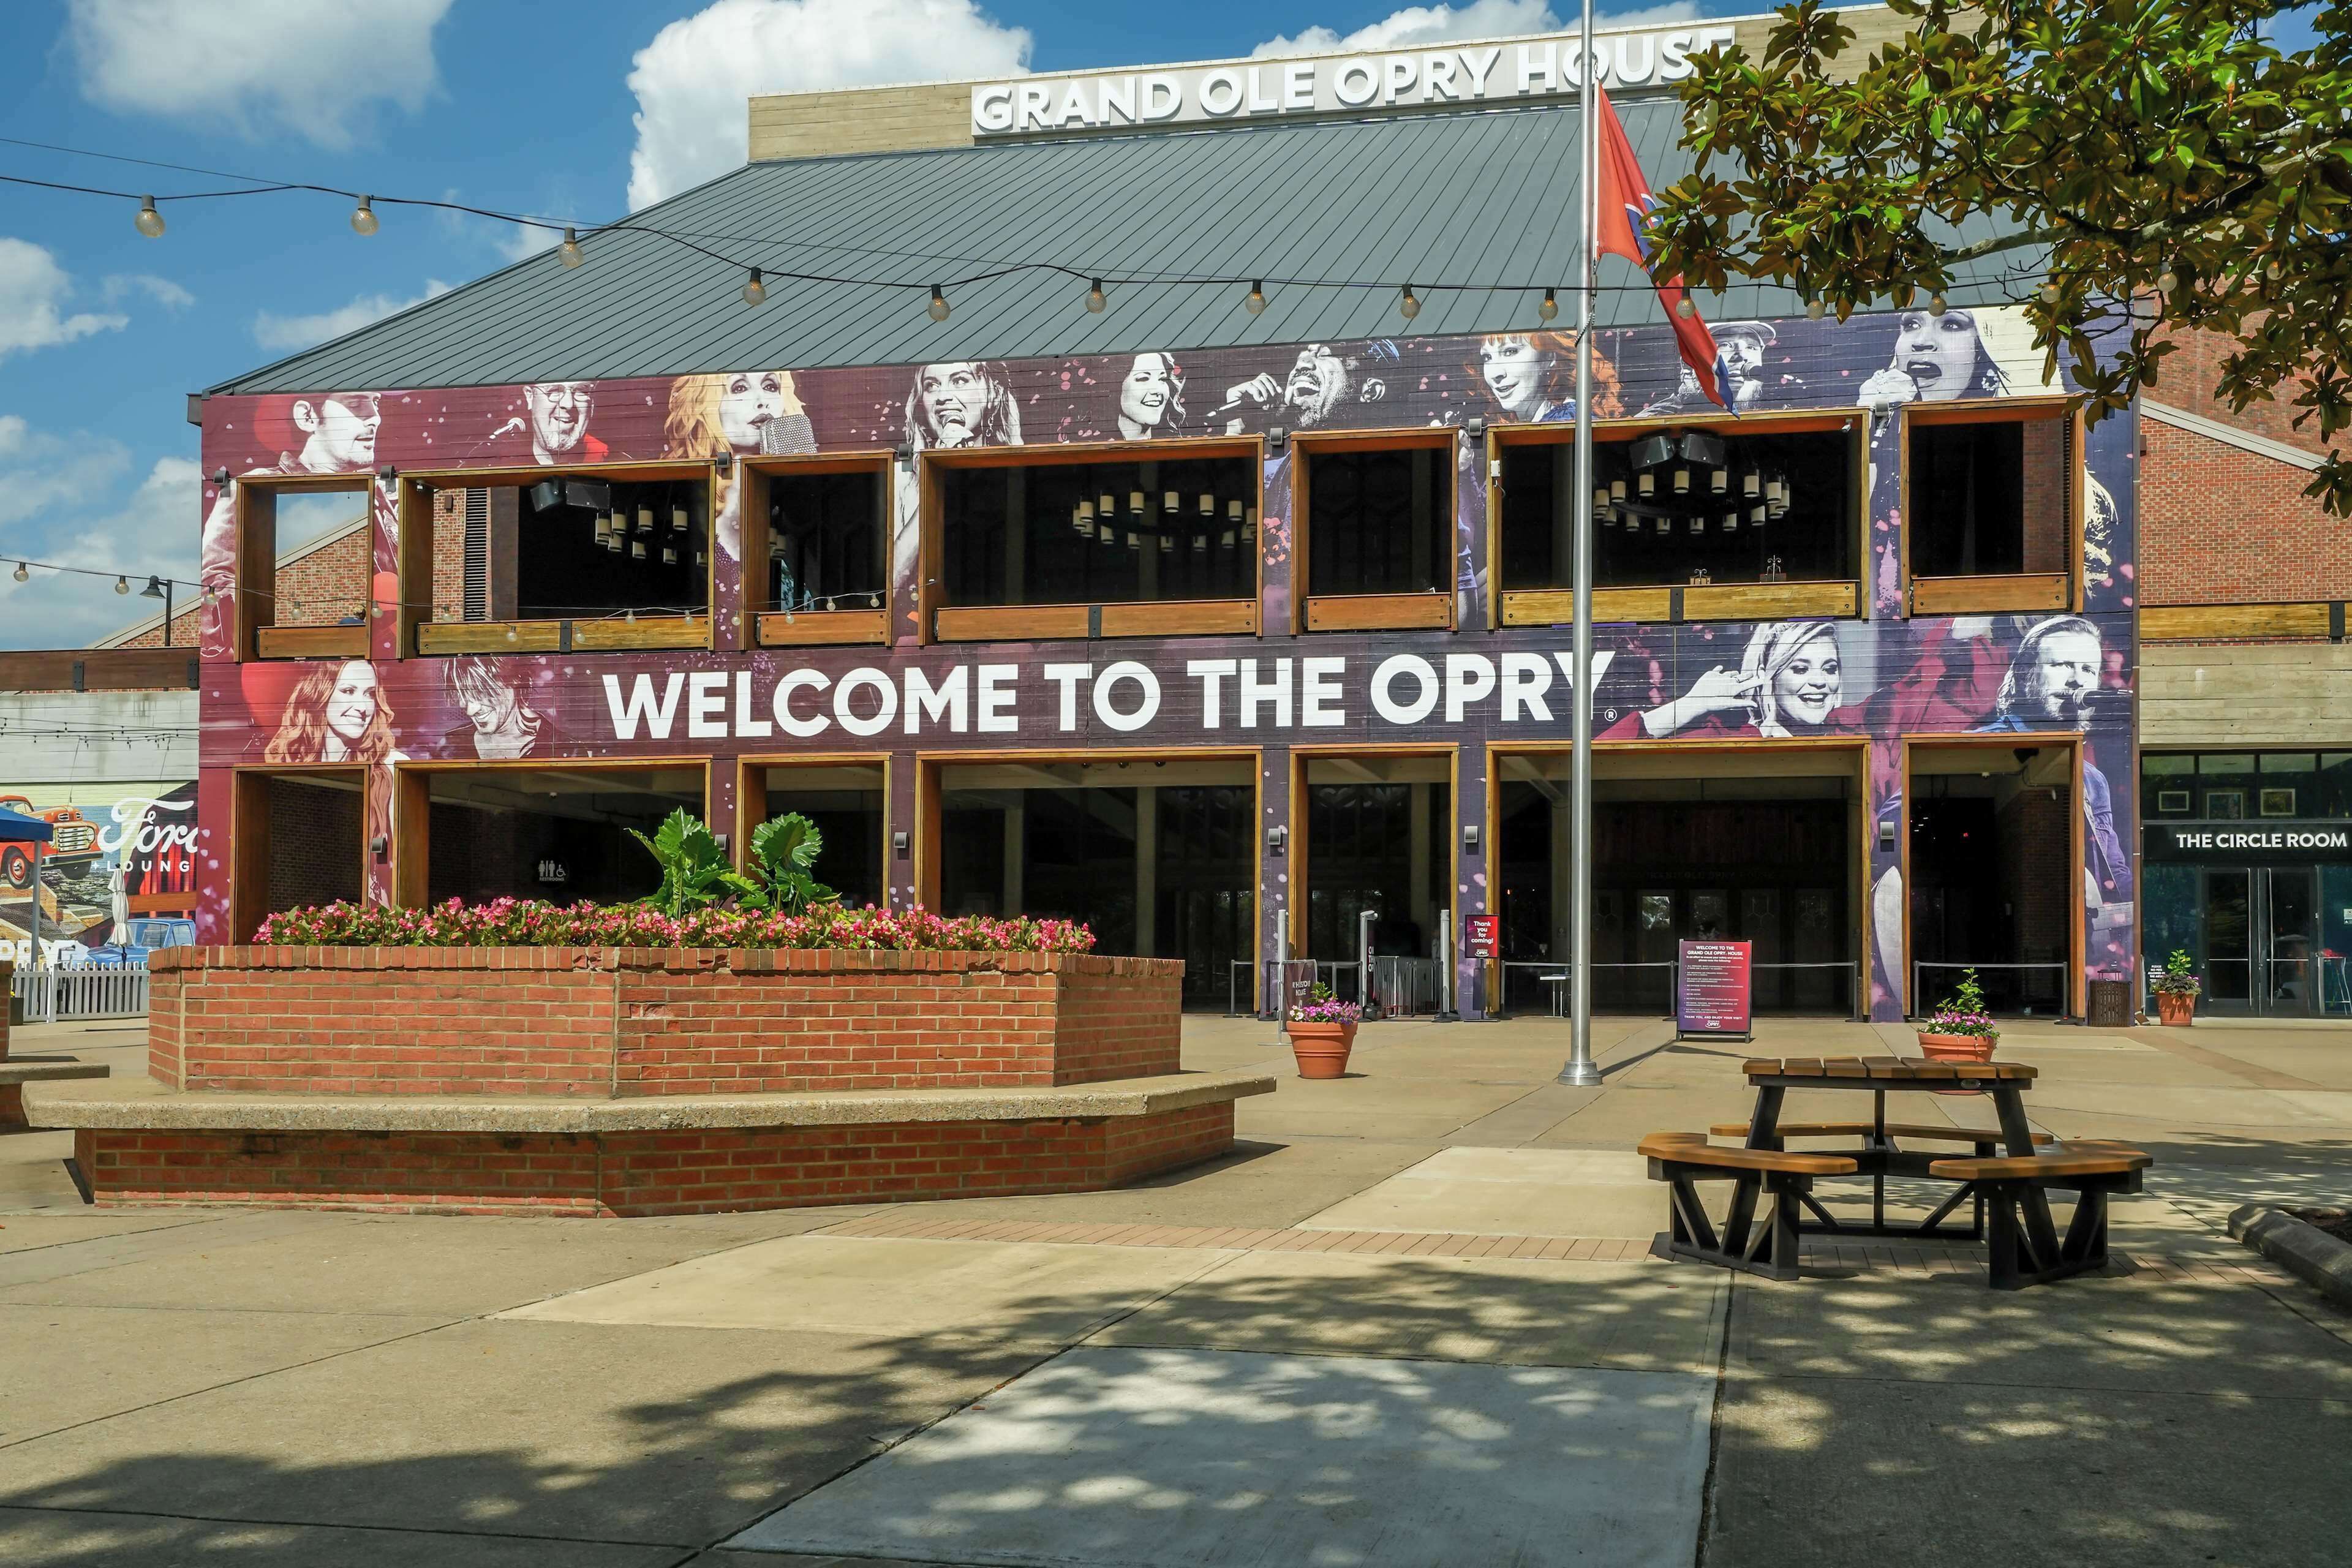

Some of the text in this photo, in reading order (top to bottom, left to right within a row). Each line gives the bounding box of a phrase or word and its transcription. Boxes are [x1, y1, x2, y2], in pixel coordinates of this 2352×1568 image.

[974, 74, 1183, 130] GRAND
[1199, 62, 1314, 115] OLE
[1334, 48, 1501, 104] OPRY
[603, 651, 1616, 739] WELCOME TO THE OPRY
[2176, 832, 2348, 848] THE CIRCLE ROOM
[107, 860, 190, 872] LOUNG
